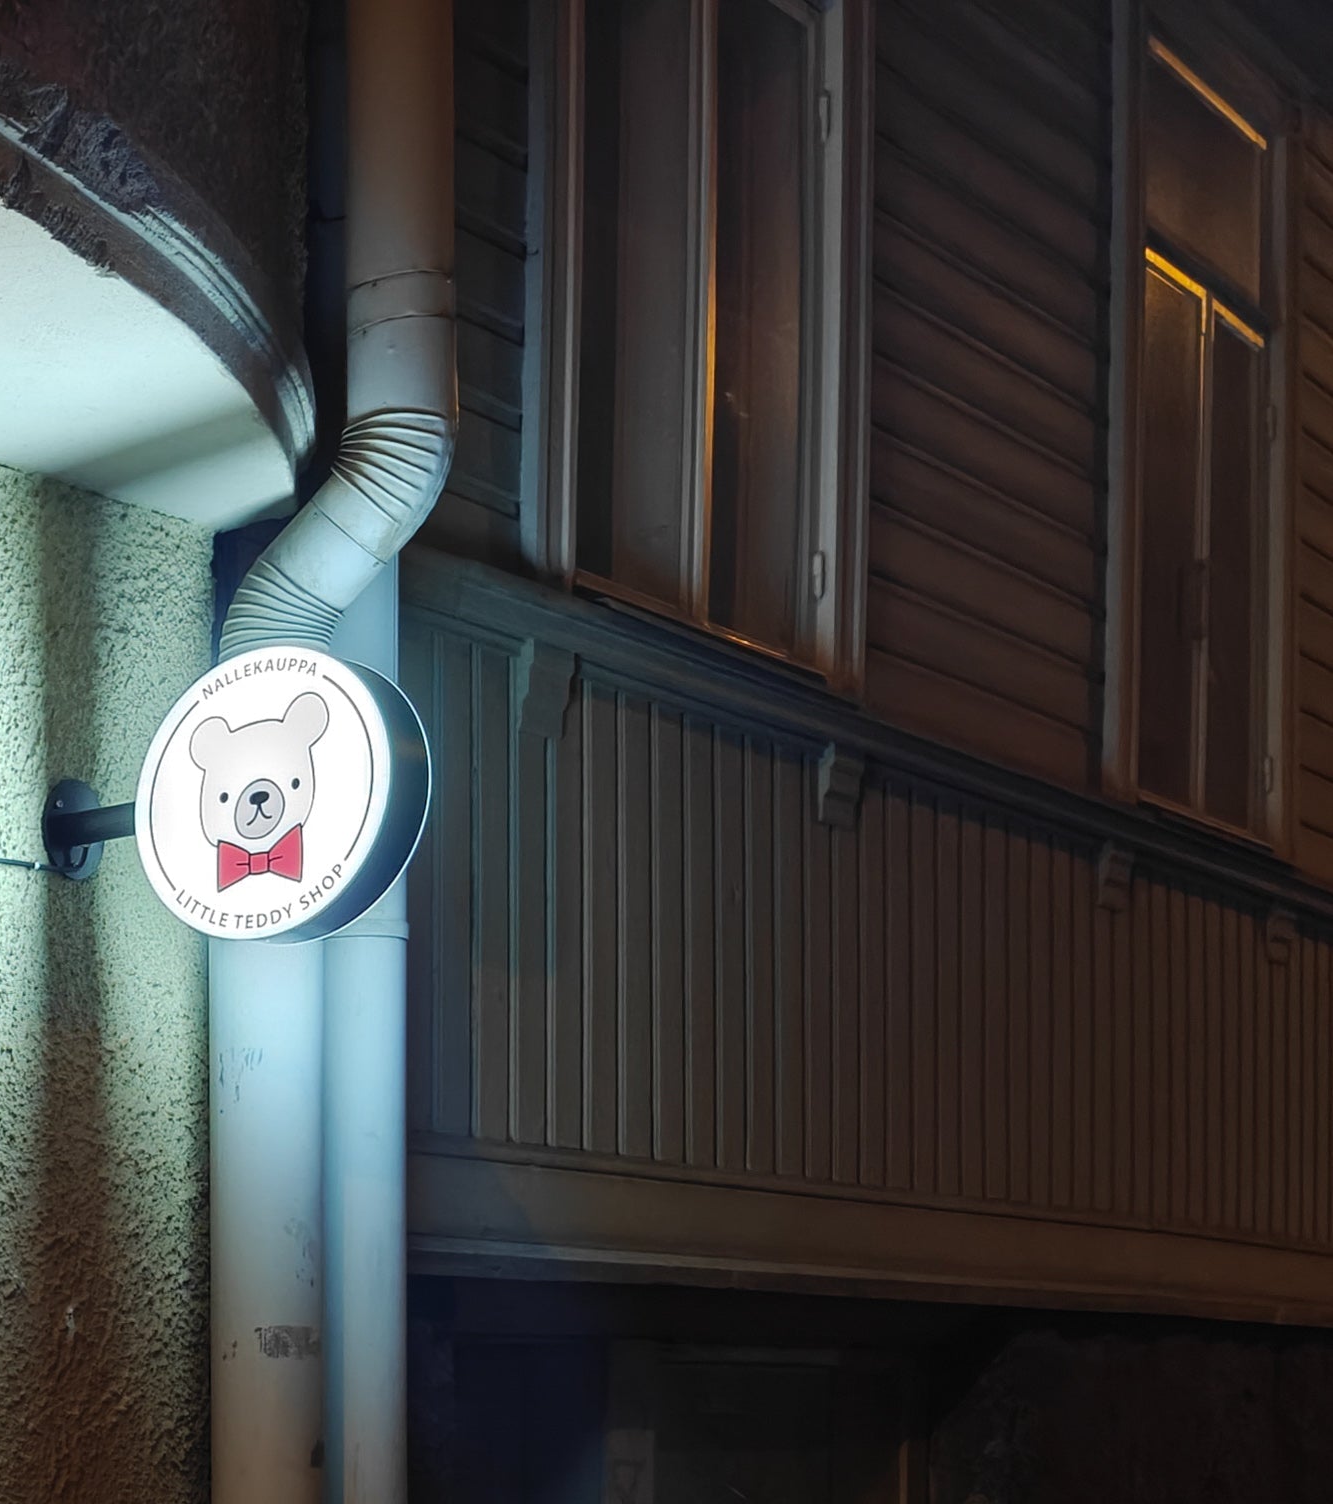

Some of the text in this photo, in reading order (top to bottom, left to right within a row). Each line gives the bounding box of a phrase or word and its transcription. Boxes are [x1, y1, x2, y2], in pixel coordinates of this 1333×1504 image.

[202, 657, 317, 700] NALLEKAUPPA
[175, 862, 343, 930] LITTLE TEDDY SHOP
